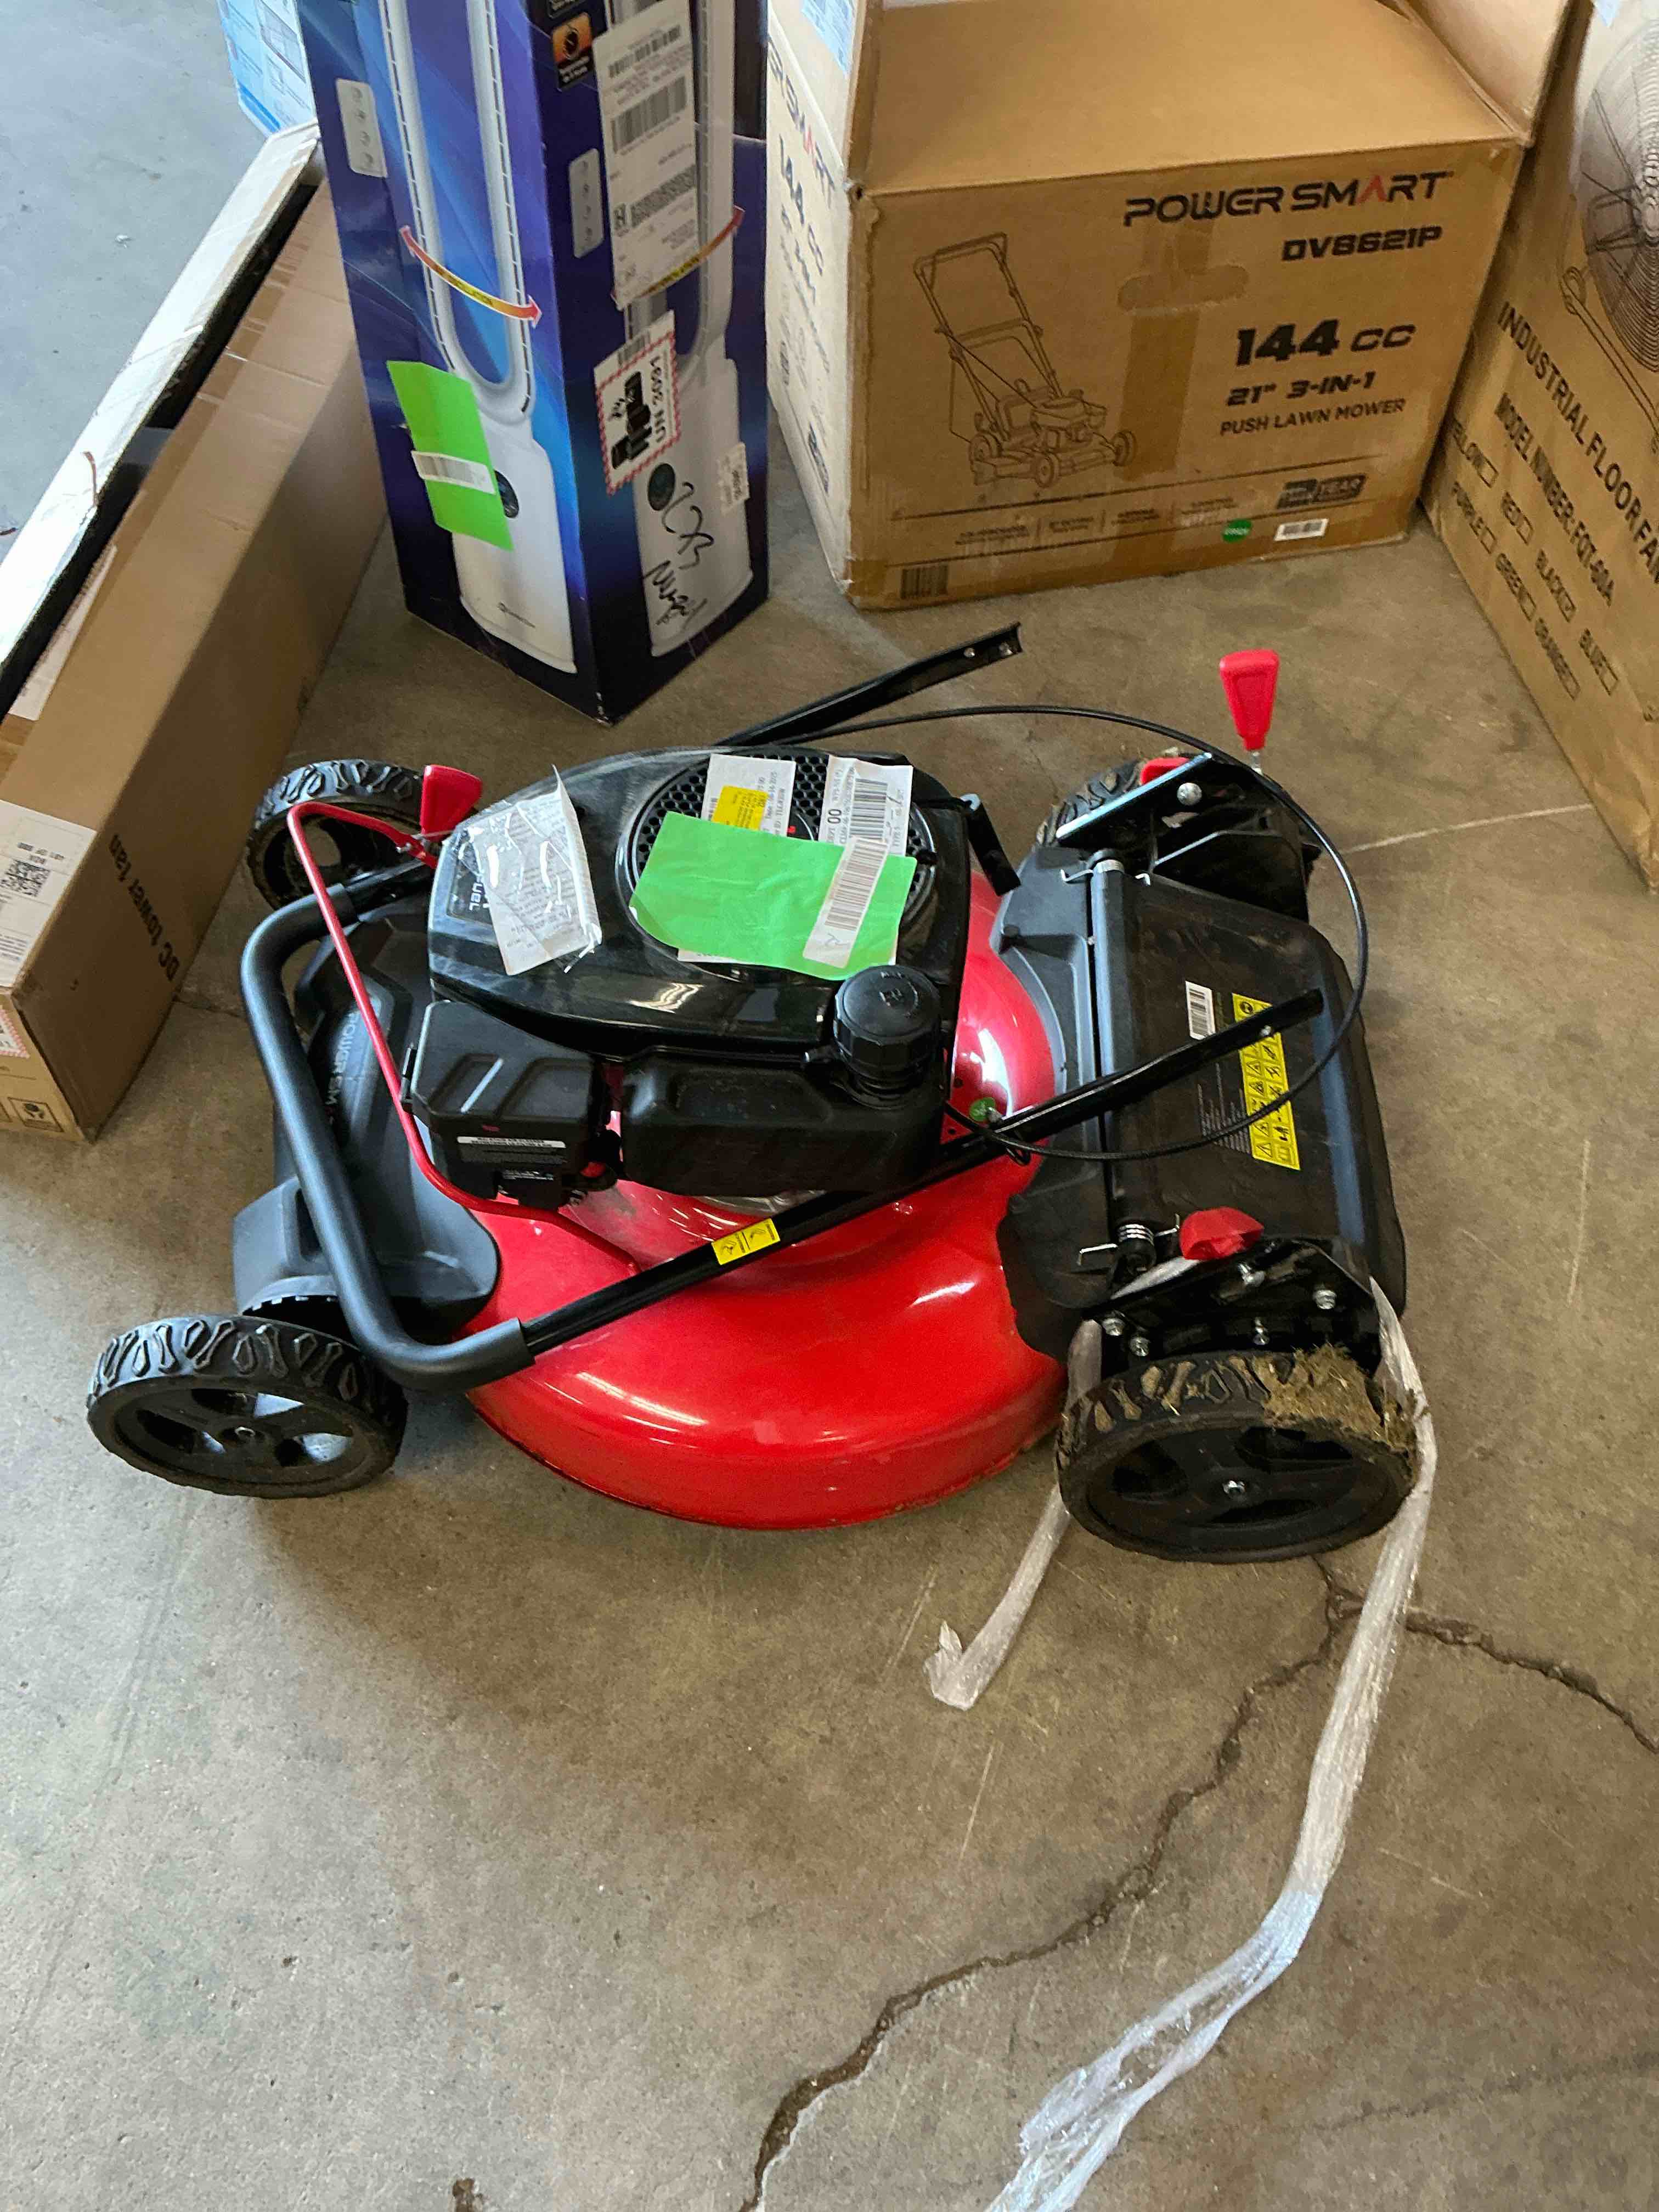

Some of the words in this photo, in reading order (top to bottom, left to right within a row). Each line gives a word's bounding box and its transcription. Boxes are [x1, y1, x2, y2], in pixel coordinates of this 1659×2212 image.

[1123, 187, 1284, 227] POWER
[1291, 171, 1448, 211] SMART
[1235, 319, 1340, 366] 144
[1285, 371, 1376, 399] 3-IN-1
[1220, 414, 1269, 436] PUSH
[1273, 409, 1331, 428] LAWN
[1335, 398, 1407, 421] MOWER
[1493, 392, 1534, 461] MODEL
[1497, 300, 1589, 445] INDUSTRIAL
[1585, 431, 1641, 532] FLOOR
[827, 809, 842, 824] 00
